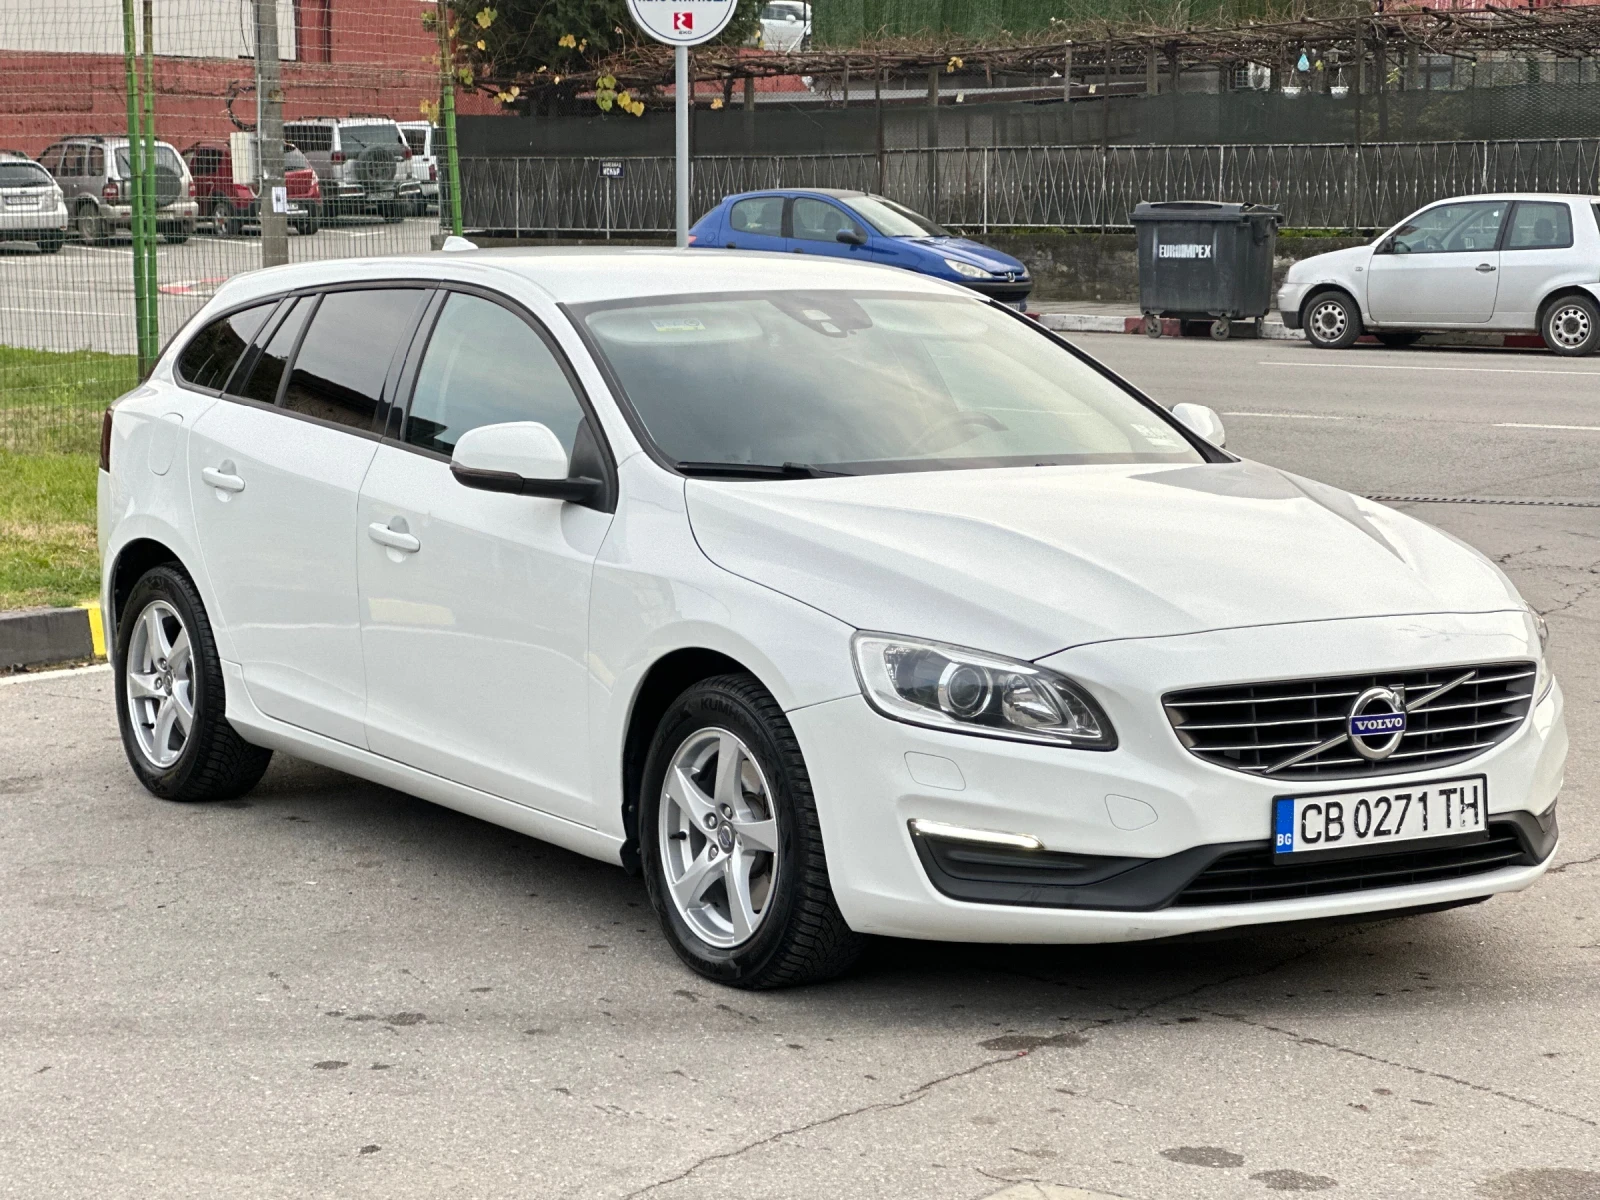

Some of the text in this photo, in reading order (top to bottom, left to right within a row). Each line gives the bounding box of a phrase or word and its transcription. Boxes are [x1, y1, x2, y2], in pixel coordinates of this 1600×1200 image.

[1159, 244, 1212, 258] EUROIMPEX
[701, 698, 746, 725] KUMHO
[1355, 717, 1403, 731] VOLVO
[1301, 785, 1479, 844] CB 0271 TH
[1276, 833, 1292, 846] BG
